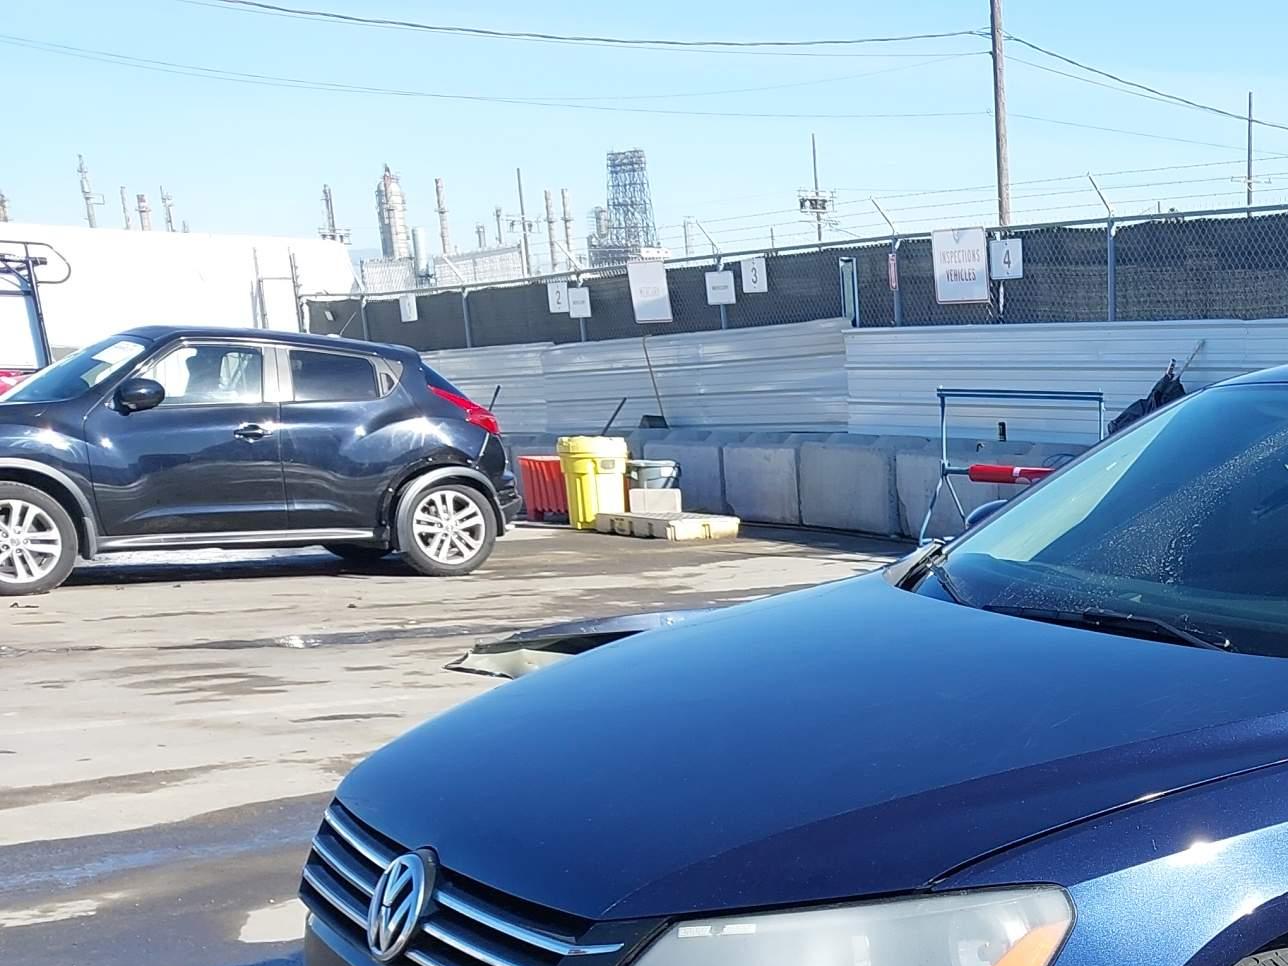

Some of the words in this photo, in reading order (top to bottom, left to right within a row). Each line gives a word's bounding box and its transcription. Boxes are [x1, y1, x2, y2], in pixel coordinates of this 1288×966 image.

[940, 248, 980, 264] INSPECTIONS
[1003, 249, 1012, 269] 4
[751, 267, 758, 284] 3
[945, 268, 976, 282] VEHICLES
[555, 290, 562, 305] 2
